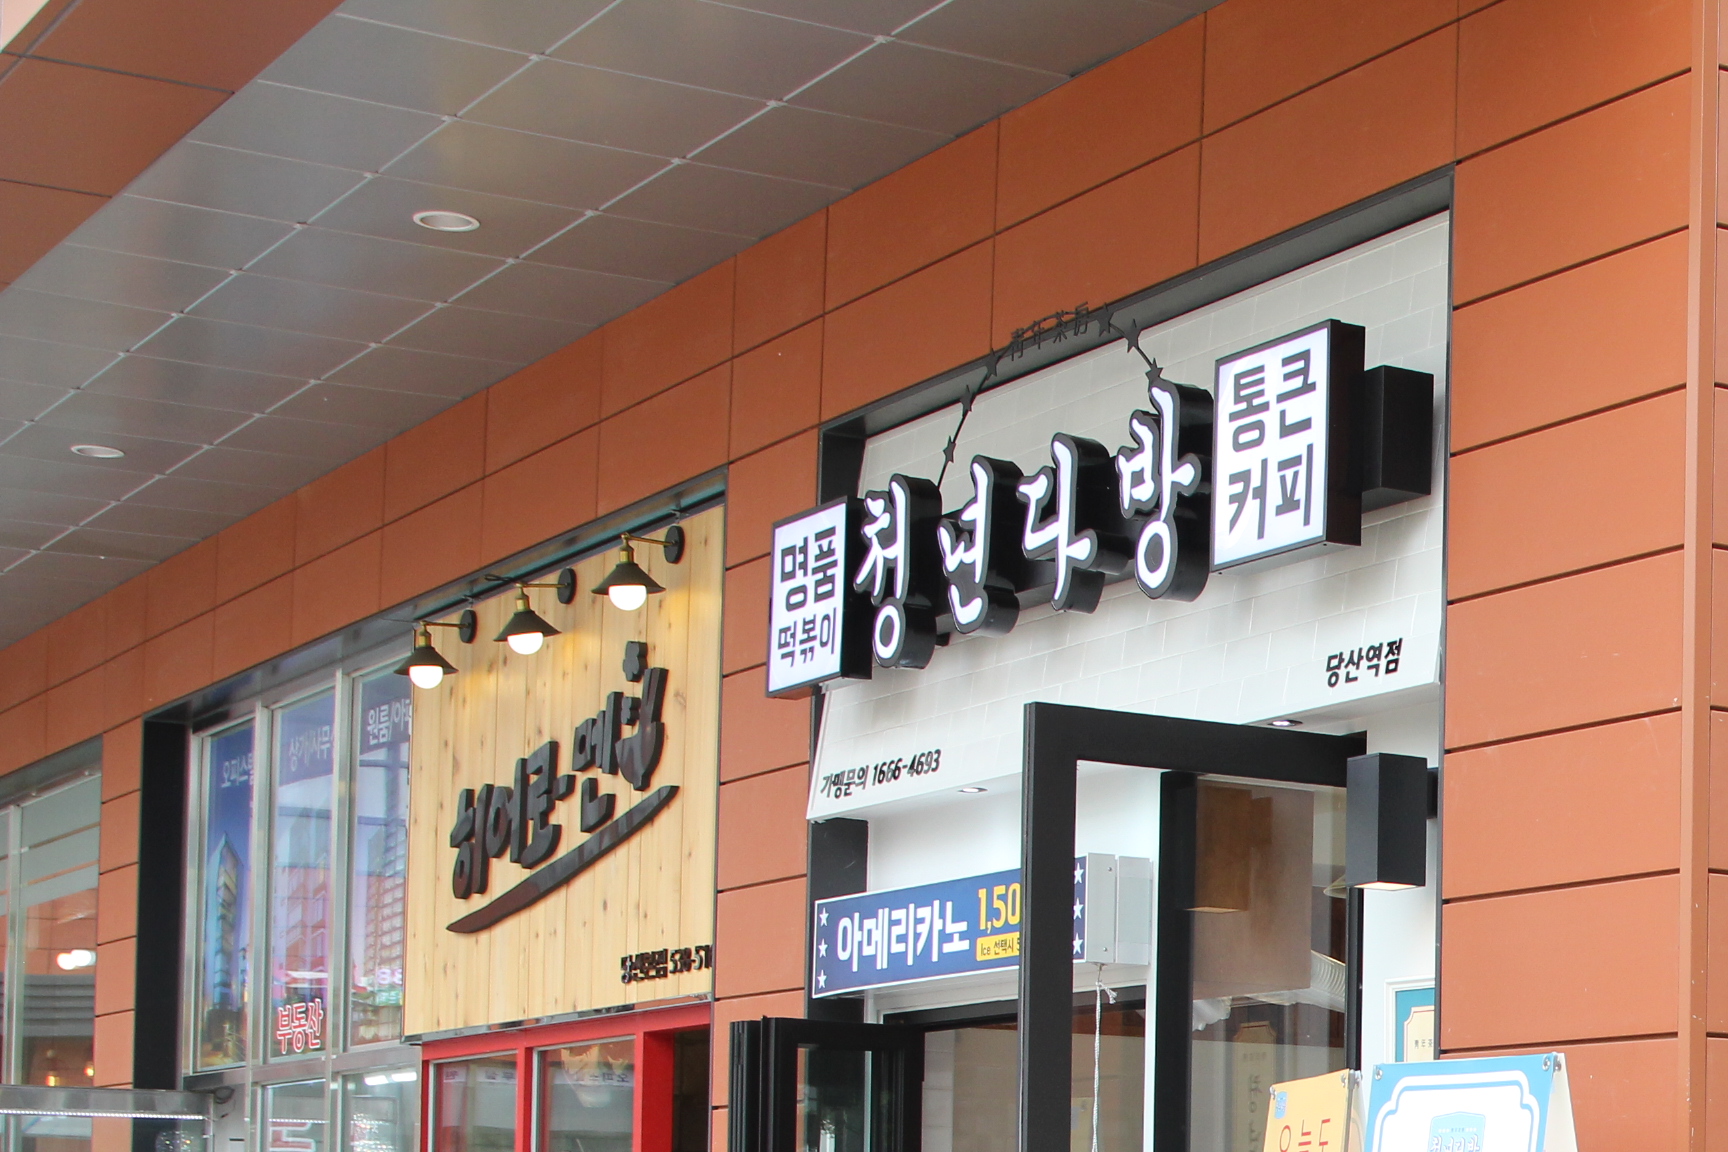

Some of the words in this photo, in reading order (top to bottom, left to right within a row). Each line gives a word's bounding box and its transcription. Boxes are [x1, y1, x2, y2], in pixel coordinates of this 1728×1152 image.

[1228, 347, 1318, 453] 통큰
[854, 385, 1202, 662] 청년다방
[1227, 443, 1314, 543] 커피
[779, 524, 839, 613] 명품
[777, 606, 837, 668] 떡볶이
[1325, 637, 1404, 688] 당산역점
[288, 724, 334, 772] 상가/사무
[820, 765, 870, 799] 가맹문의
[872, 749, 942, 786] 1666-4693
[837, 900, 970, 972] 아메리카노
[276, 998, 324, 1055] 부동산
